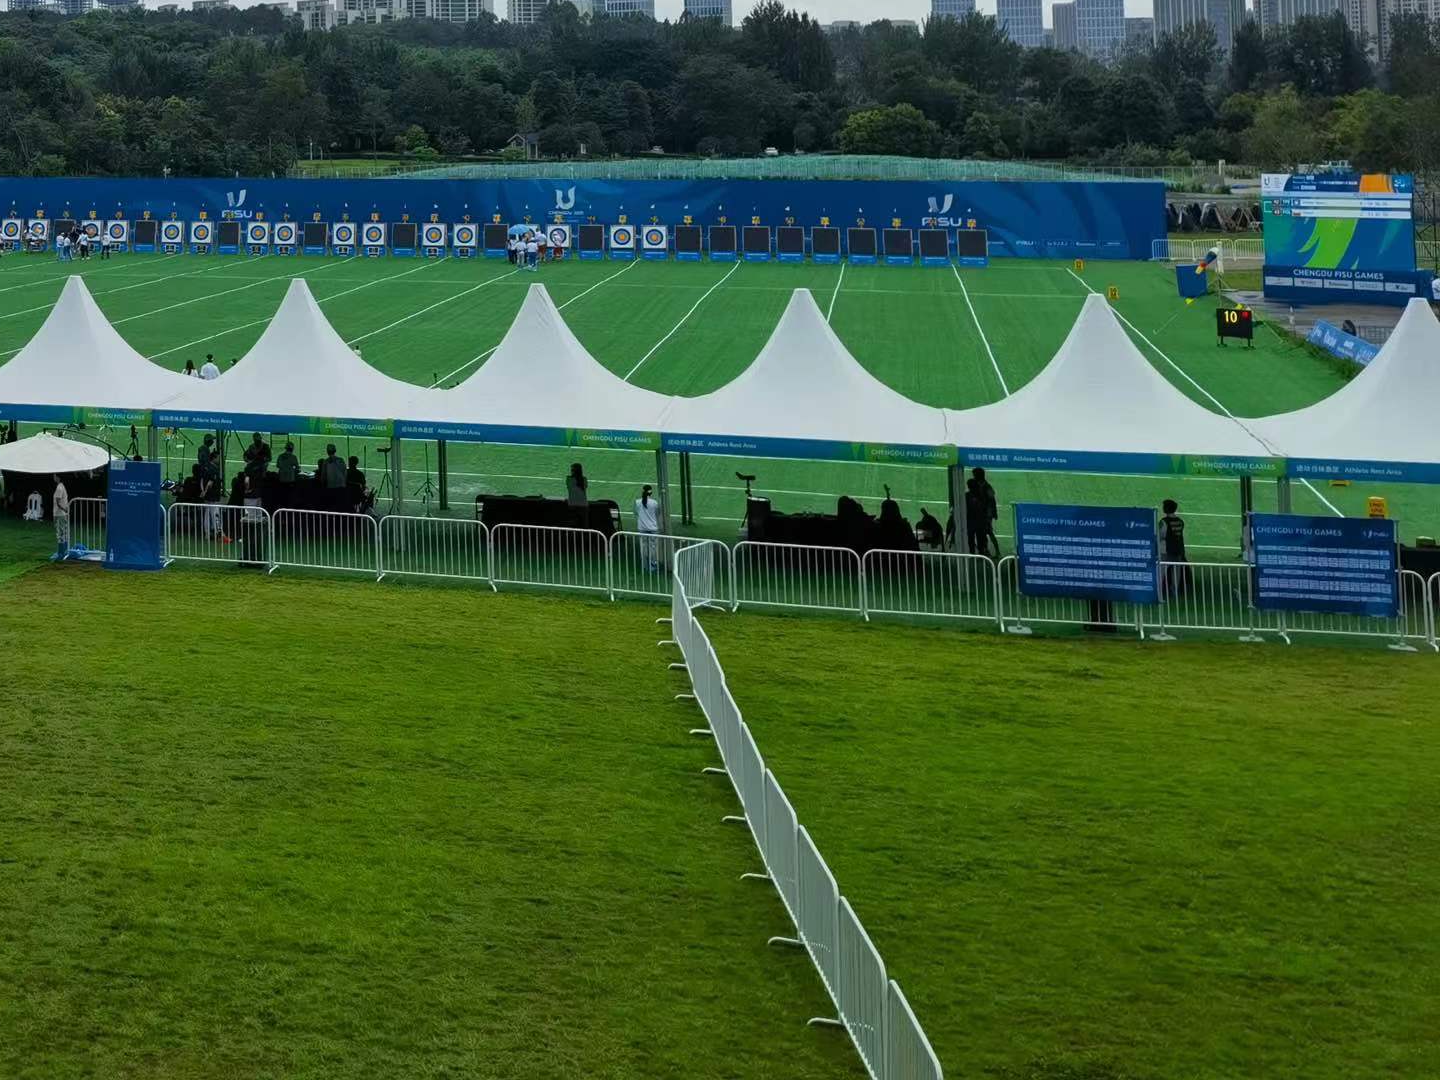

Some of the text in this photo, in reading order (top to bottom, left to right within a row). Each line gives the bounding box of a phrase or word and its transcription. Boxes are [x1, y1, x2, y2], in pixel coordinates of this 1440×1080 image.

[221, 210, 252, 218] FISU
[921, 217, 962, 226] FISU
[1293, 269, 1384, 280] CHENGDU FISU GAMES
[1224, 310, 1238, 323] 10
[1231, 462, 1249, 470] FISU
[1314, 529, 1343, 537] GAMES
